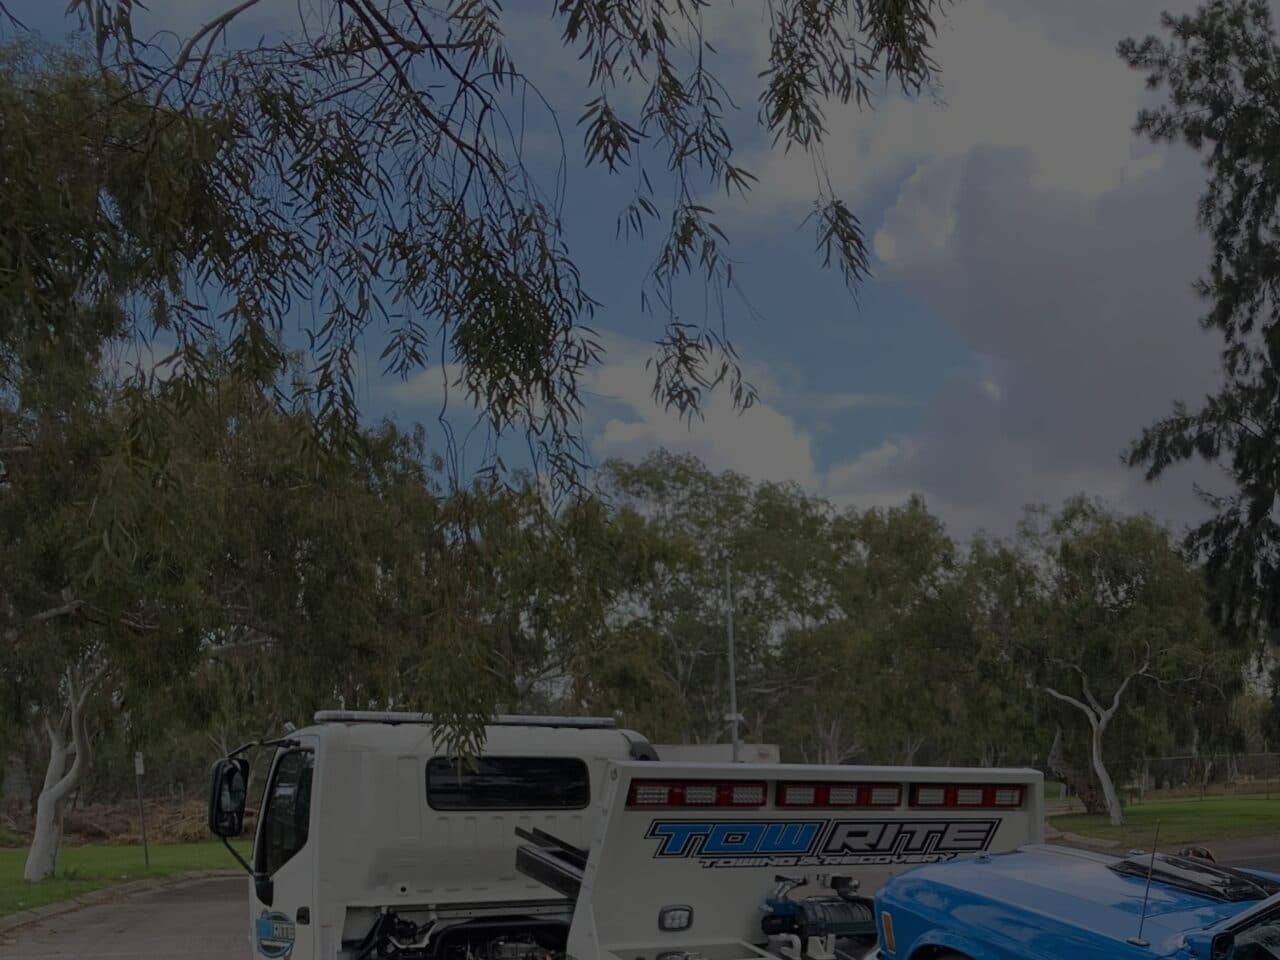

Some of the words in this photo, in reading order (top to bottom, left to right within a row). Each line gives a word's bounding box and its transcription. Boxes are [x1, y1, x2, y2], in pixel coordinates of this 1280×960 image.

[647, 818, 828, 858] TOW
[826, 818, 1001, 857] RITE
[700, 855, 799, 868] TOWING
[820, 852, 957, 866] RECOVERY
